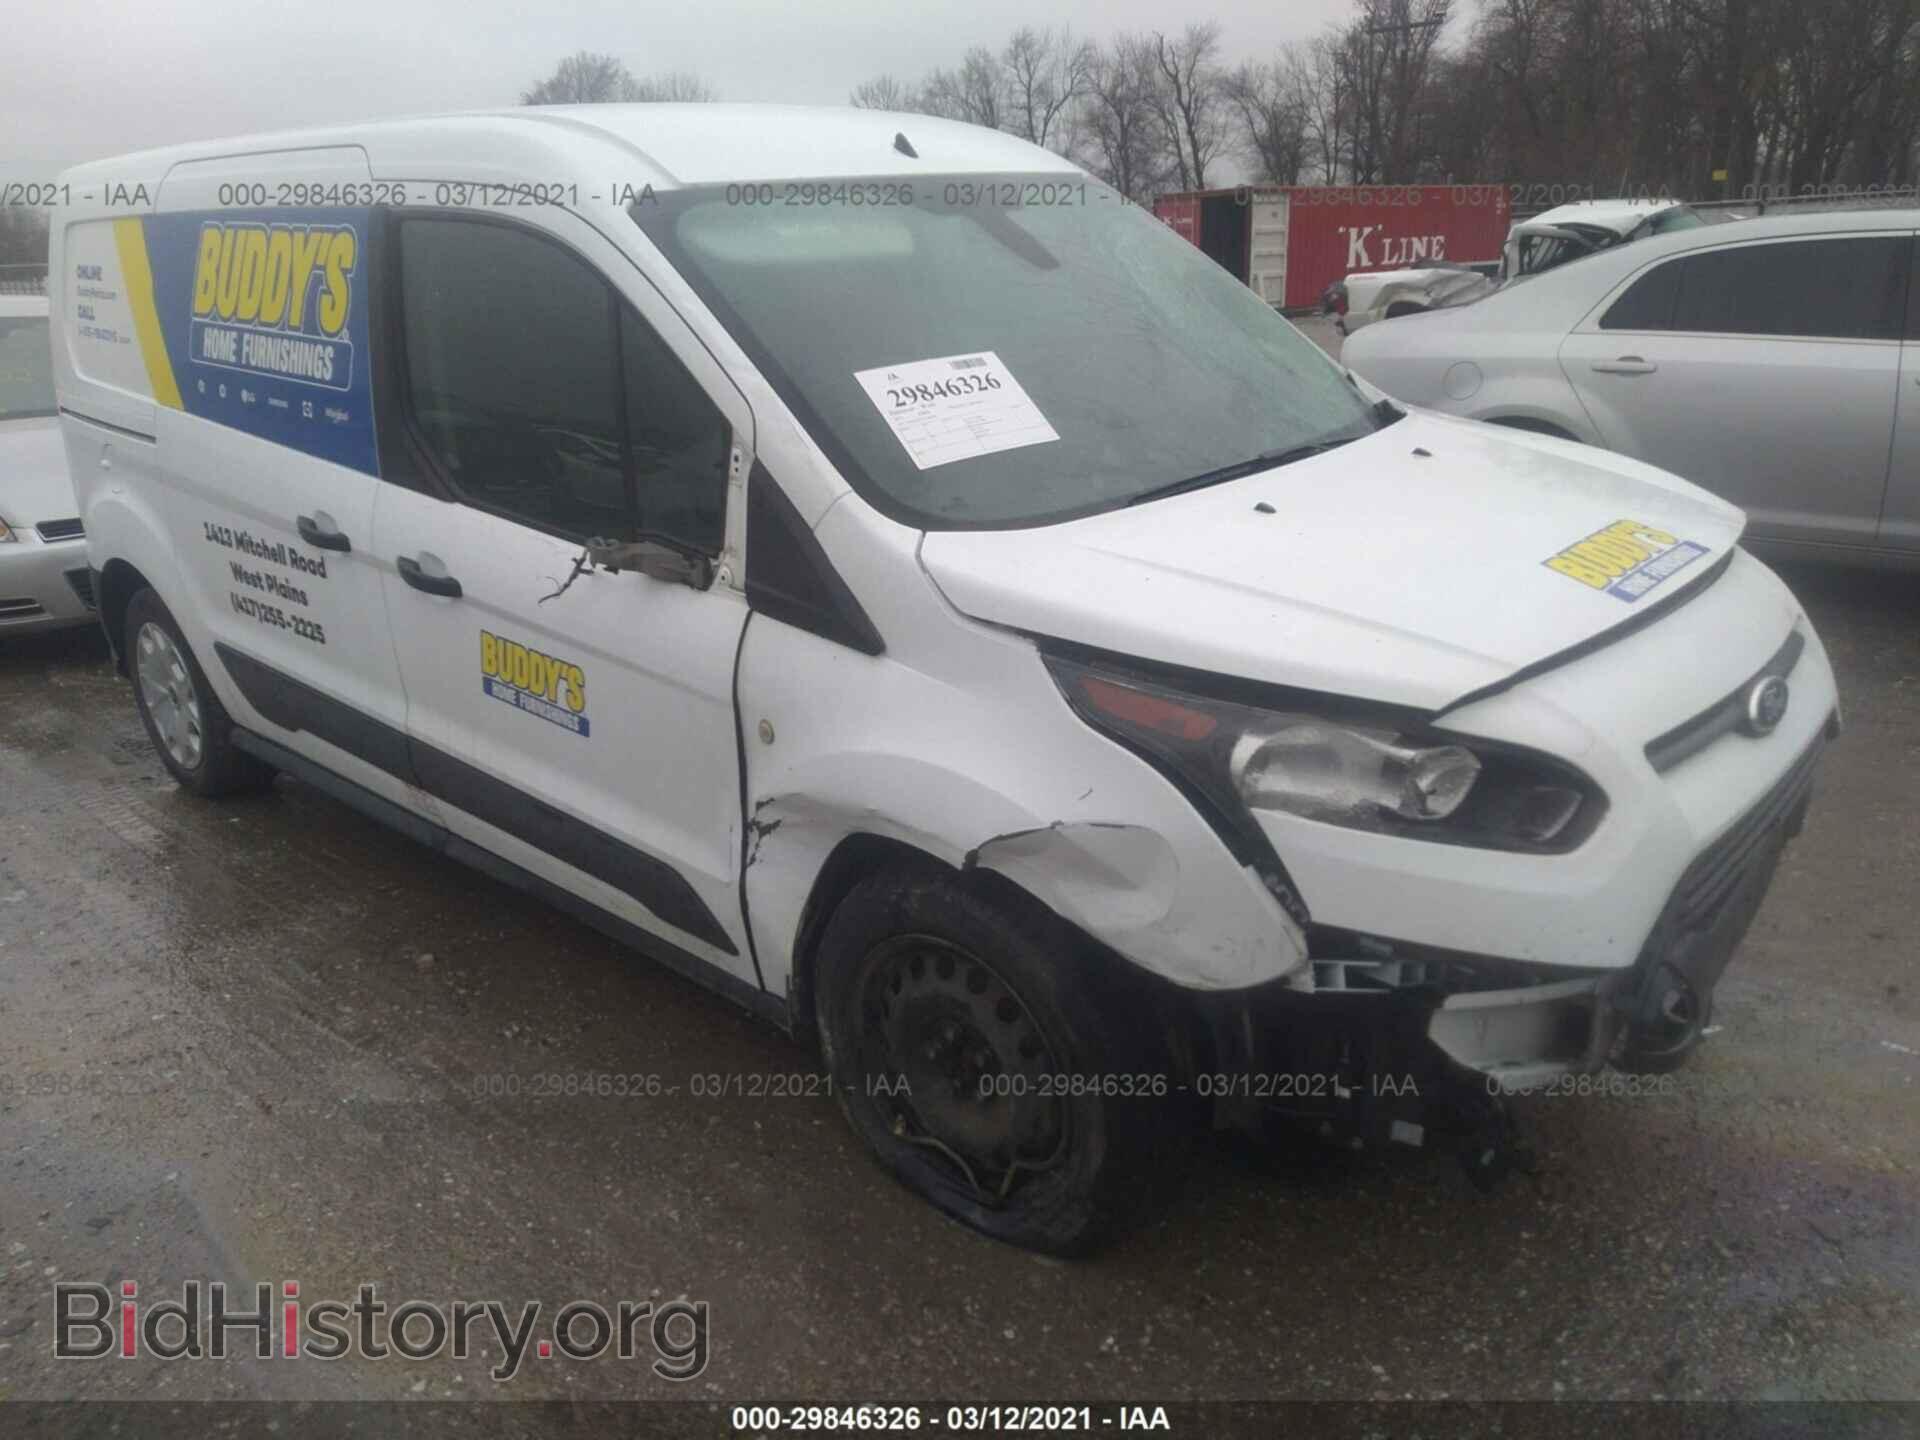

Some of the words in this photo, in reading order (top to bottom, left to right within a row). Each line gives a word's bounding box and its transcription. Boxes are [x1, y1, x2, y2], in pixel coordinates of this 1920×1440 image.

[1381, 235, 1445, 266] LINE
[193, 224, 355, 334] BUDDY'S
[203, 327, 238, 363] HOME
[241, 333, 335, 381] FURNISHINGS
[887, 371, 1002, 408] 29846326
[233, 529, 287, 566] Mitchell
[288, 546, 328, 579] Road
[230, 560, 264, 591] West
[264, 573, 308, 607] Plains
[480, 629, 585, 713] BUDDY'S
